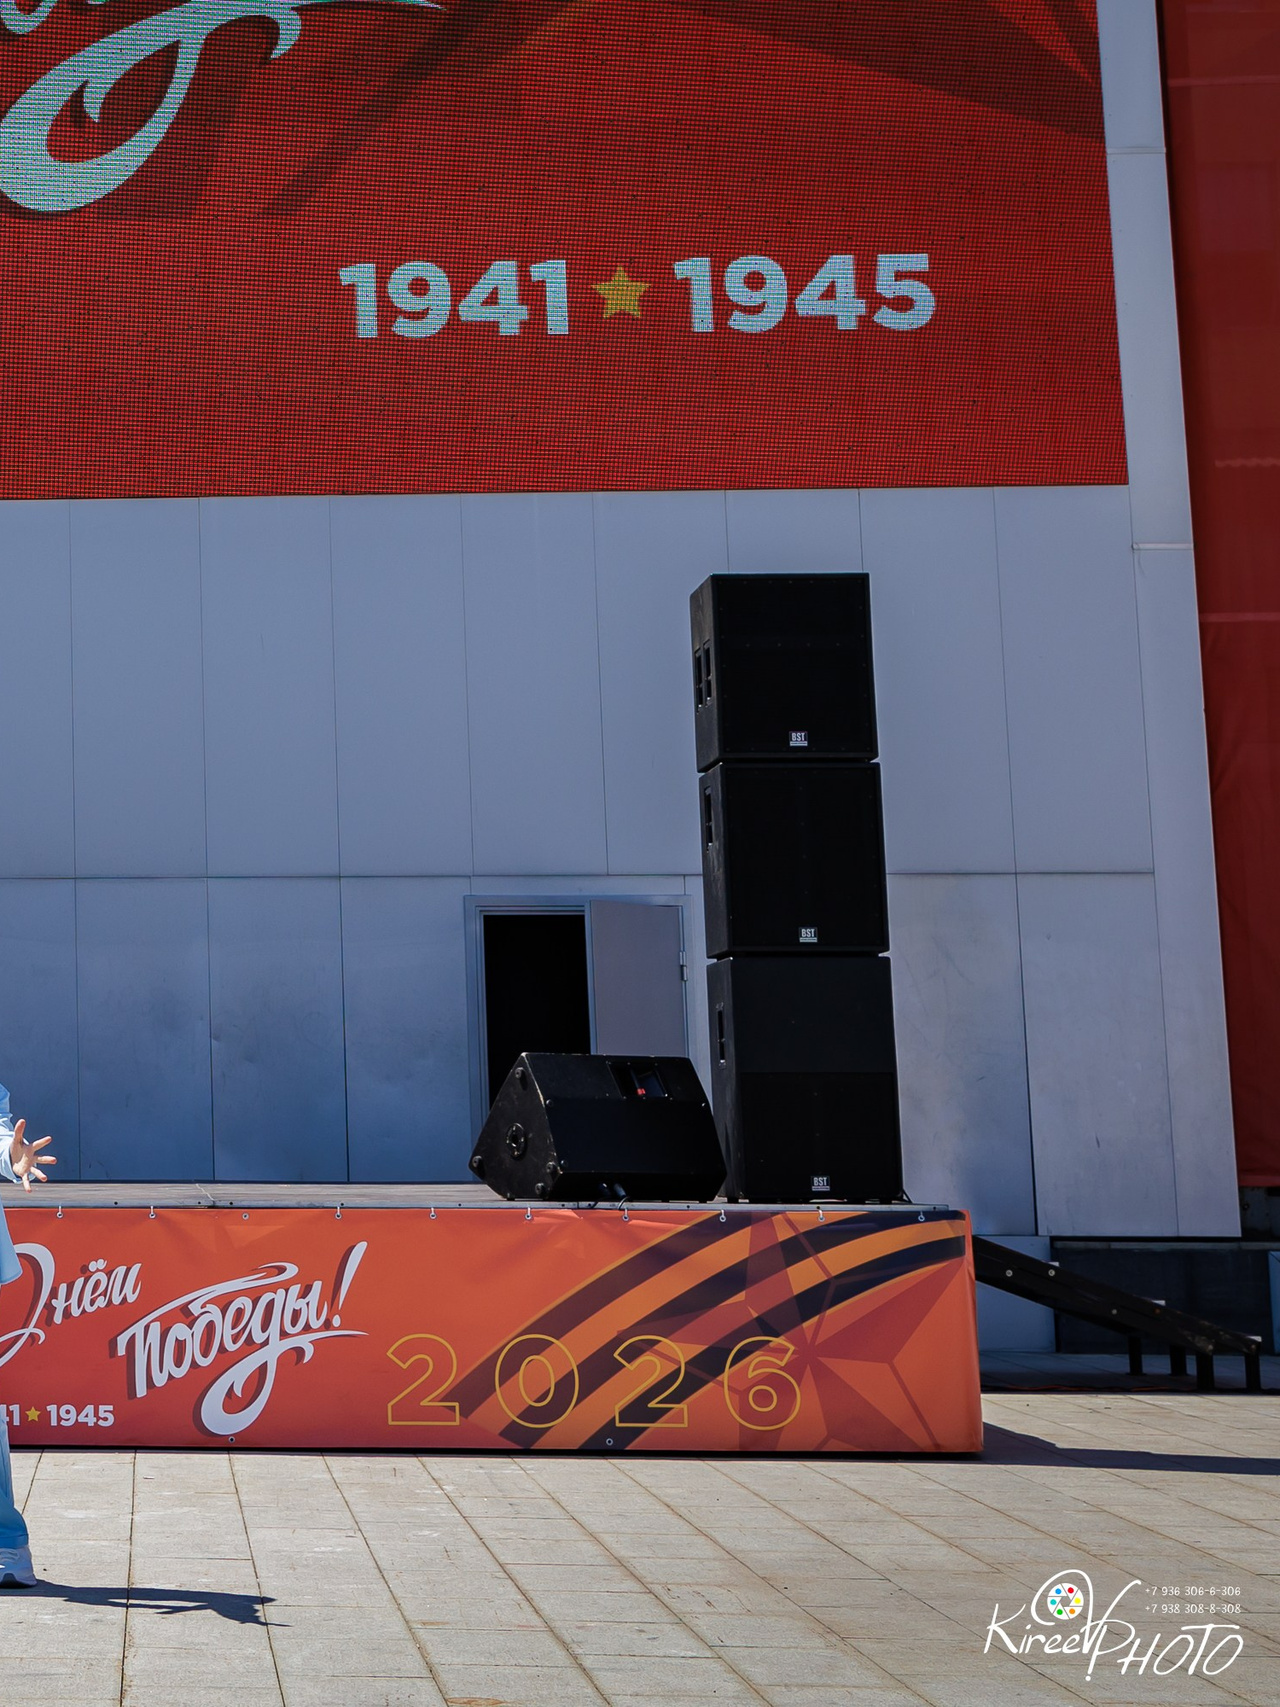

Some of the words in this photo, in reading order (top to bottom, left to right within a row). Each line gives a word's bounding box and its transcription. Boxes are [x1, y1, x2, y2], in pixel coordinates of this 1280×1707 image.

[338, 260, 569, 338] 1941
[673, 253, 936, 333] 1945
[791, 732, 806, 742] BST
[801, 928, 816, 938] BST
[813, 1177, 828, 1186] BST
[386, 1333, 801, 1430] 2026
[46, 1404, 115, 1427] 1945
